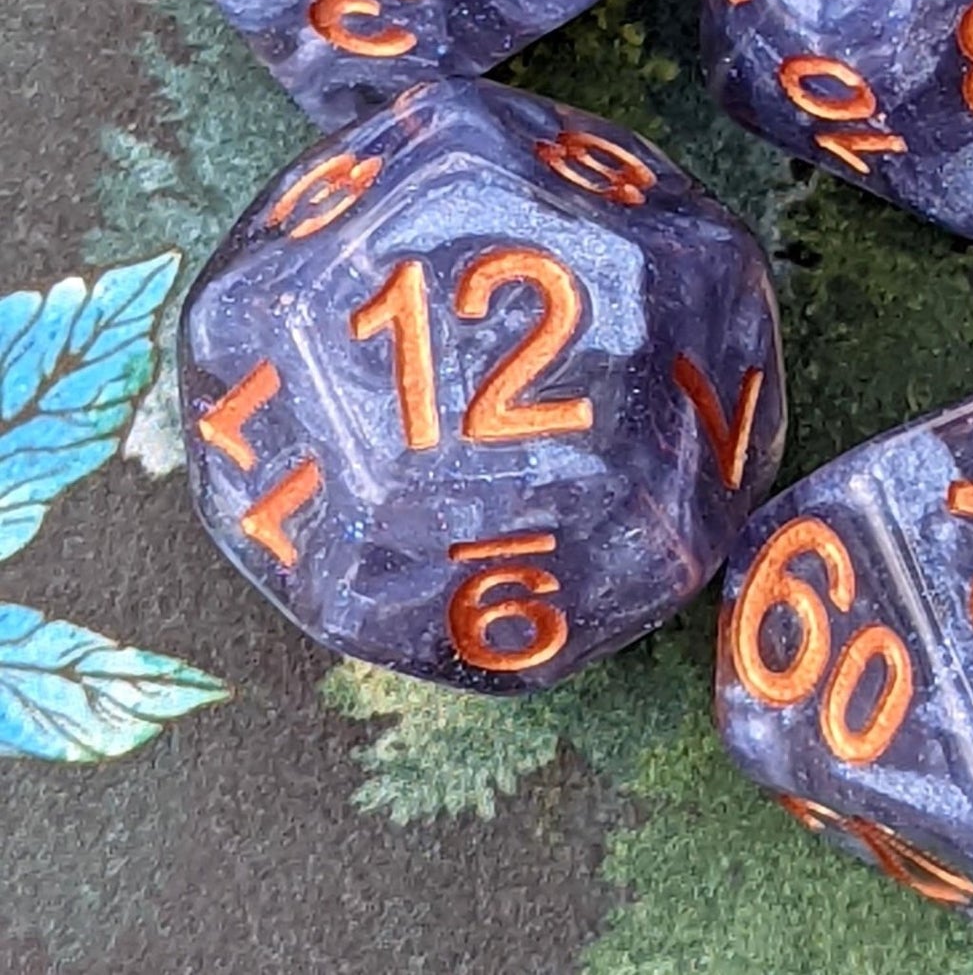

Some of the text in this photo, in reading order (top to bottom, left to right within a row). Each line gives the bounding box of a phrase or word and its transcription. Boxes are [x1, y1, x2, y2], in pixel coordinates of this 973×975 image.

[776, 54, 909, 175] 10
[349, 246, 594, 452] 12
[731, 516, 915, 766] 60
